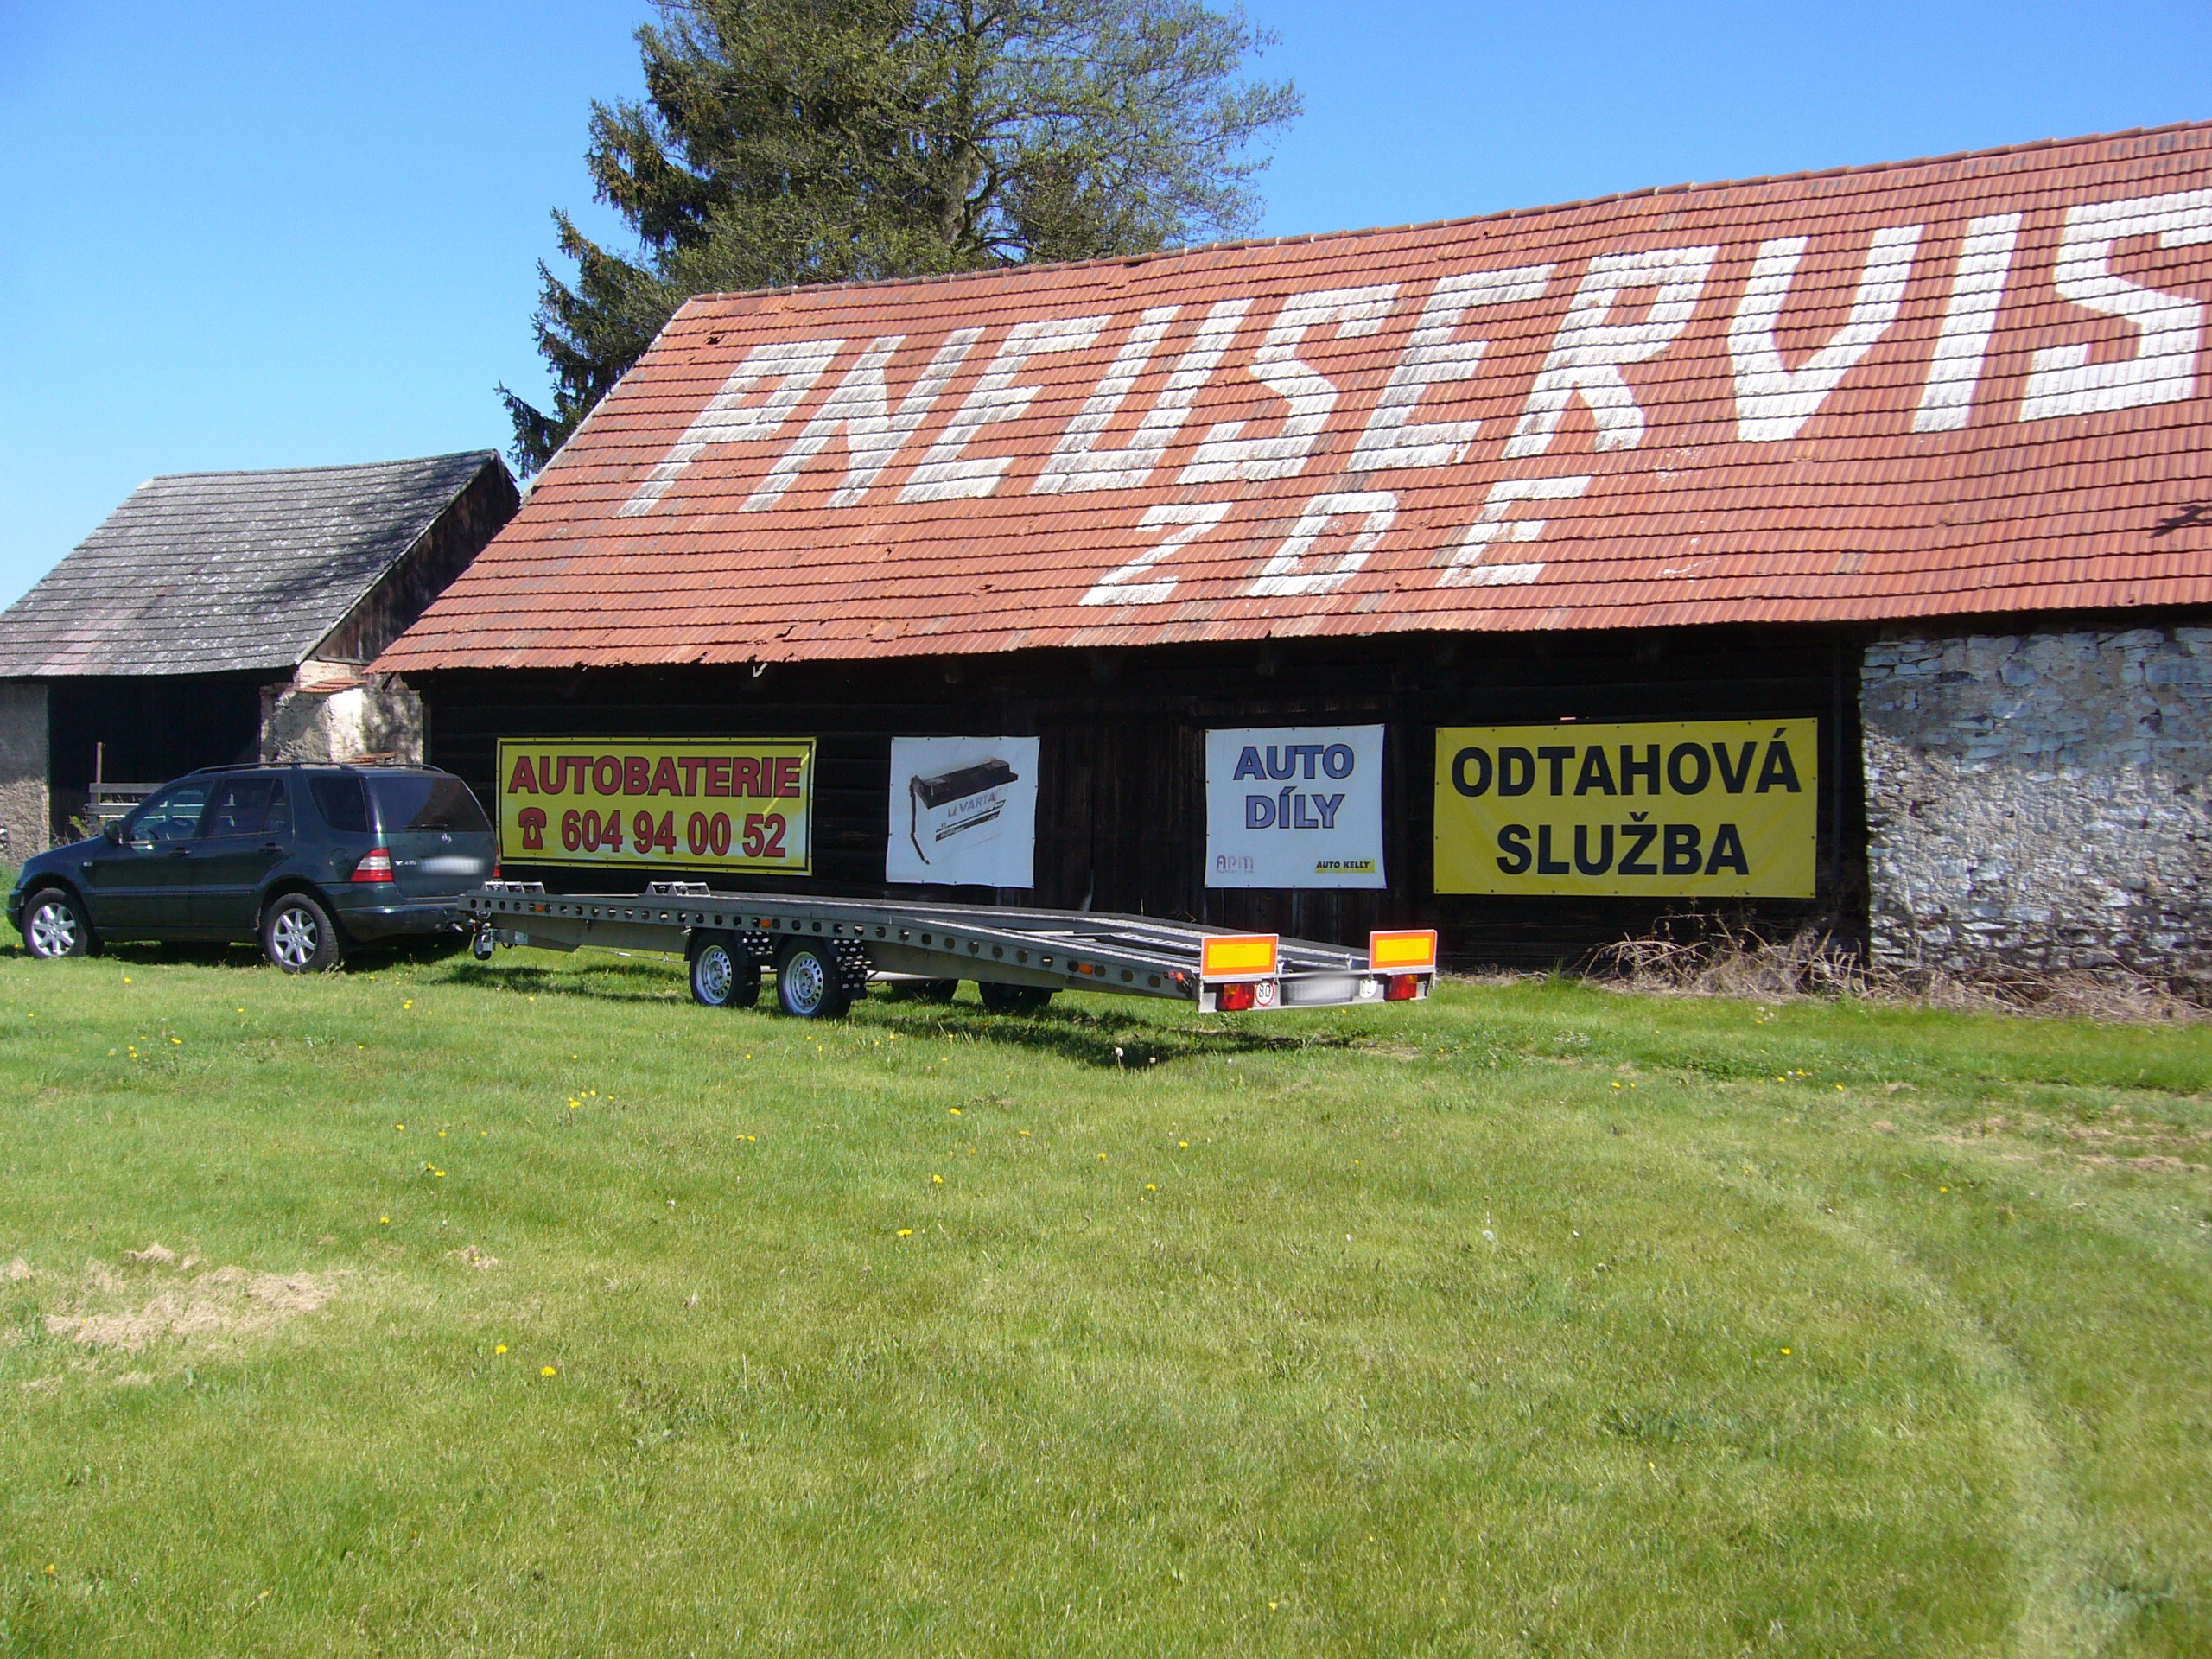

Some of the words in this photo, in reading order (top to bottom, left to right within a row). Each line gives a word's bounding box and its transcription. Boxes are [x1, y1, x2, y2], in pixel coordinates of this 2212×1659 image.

[1078, 475, 1591, 607] ZDE
[507, 755, 802, 798] AUTOBATERIE
[1233, 743, 1355, 780] AUTO
[1452, 727, 1802, 798] ODTAHOVÁ
[959, 792, 996, 812] VARTA
[1246, 785, 1345, 830] DÍLY
[561, 809, 623, 853] 604
[633, 810, 677, 855] 94
[687, 812, 731, 856] 00
[742, 813, 786, 858] 52
[1496, 811, 1750, 875] SLUŽBA
[1258, 983, 1271, 998] 80
